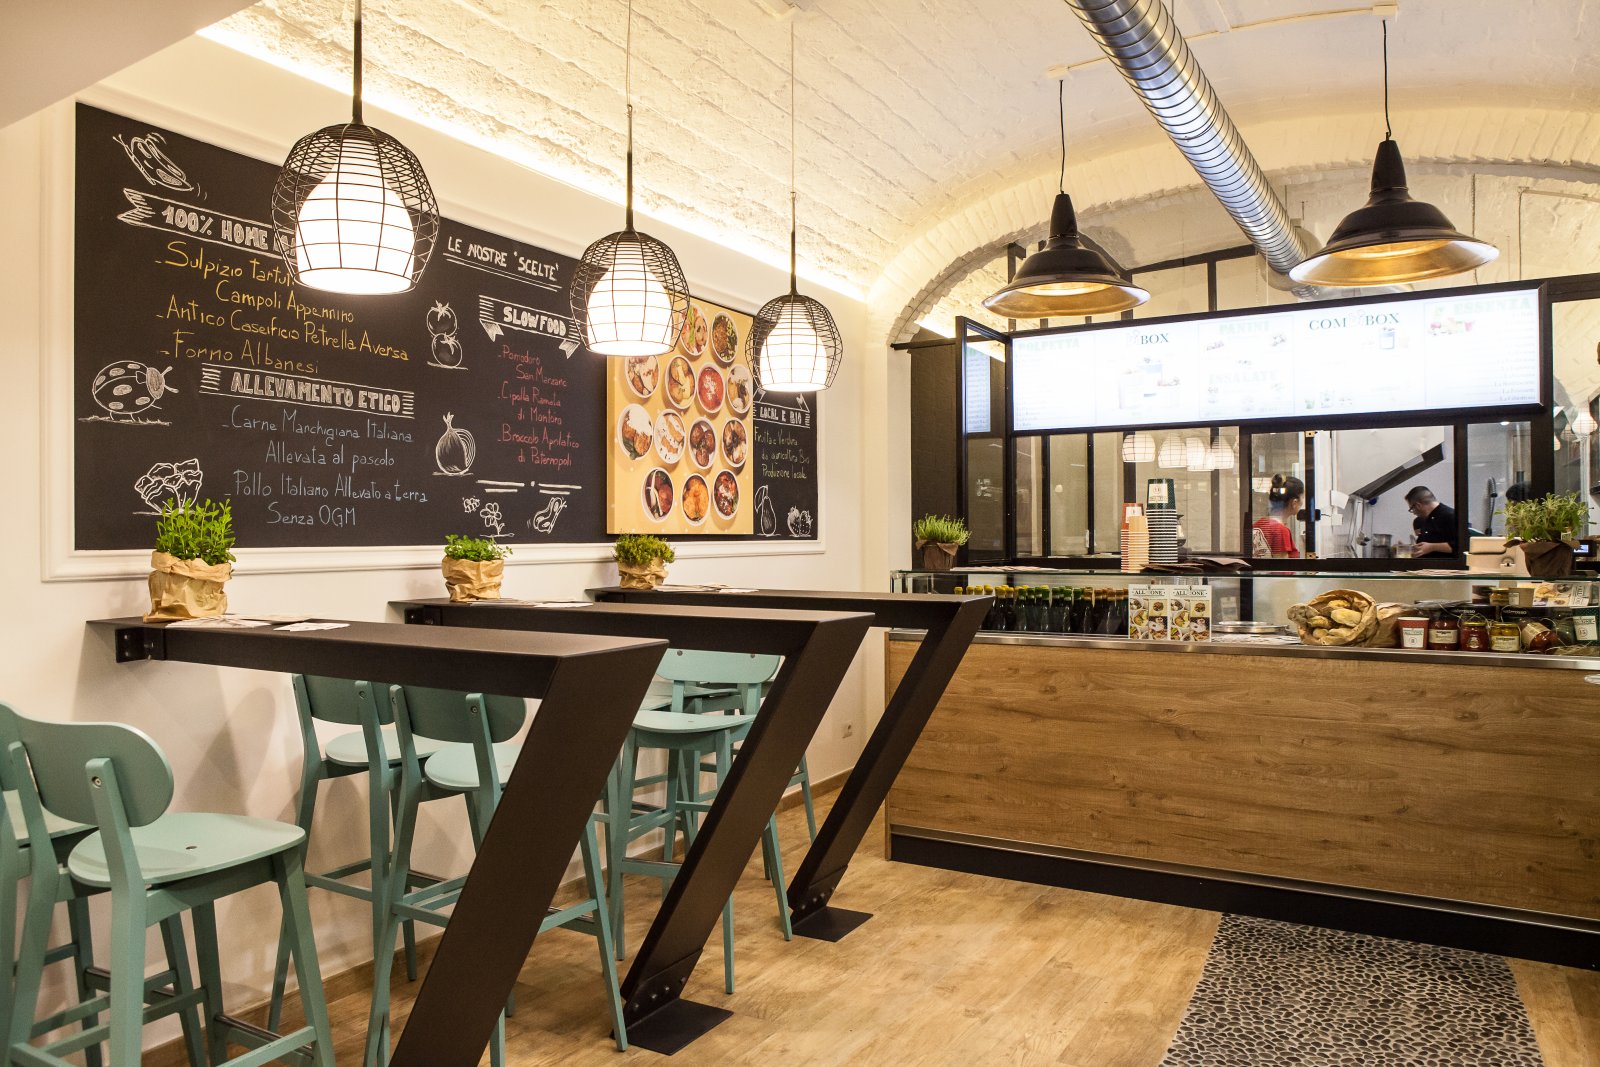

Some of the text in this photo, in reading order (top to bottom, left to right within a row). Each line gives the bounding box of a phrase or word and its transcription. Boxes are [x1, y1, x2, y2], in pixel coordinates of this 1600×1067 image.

[161, 204, 213, 236] 100%
[221, 218, 269, 250] HOME
[165, 241, 243, 282] Sulpizio
[447, 236, 462, 253] LE
[466, 243, 508, 268] NOSTRE
[216, 280, 282, 311] Campoli
[167, 294, 225, 327] Antico
[304, 324, 357, 351] Petrella
[360, 331, 409, 360] Aversa
[1309, 317, 1346, 330] COM
[1365, 313, 1400, 326] BOX
[174, 329, 319, 374] Forno Albanesi
[1141, 332, 1169, 345] BOX
[231, 371, 401, 413] ALLEVAMENTO ETICO
[231, 405, 277, 432] Carne
[367, 419, 414, 443] Italiana
[517, 408, 525, 421] di
[265, 440, 395, 474] Allevata al pascolo
[518, 448, 526, 463] di
[234, 469, 272, 497] Pollo
[281, 473, 329, 498] Italiano
[335, 472, 382, 500] Allevato
[267, 501, 357, 527] Senza OGM
